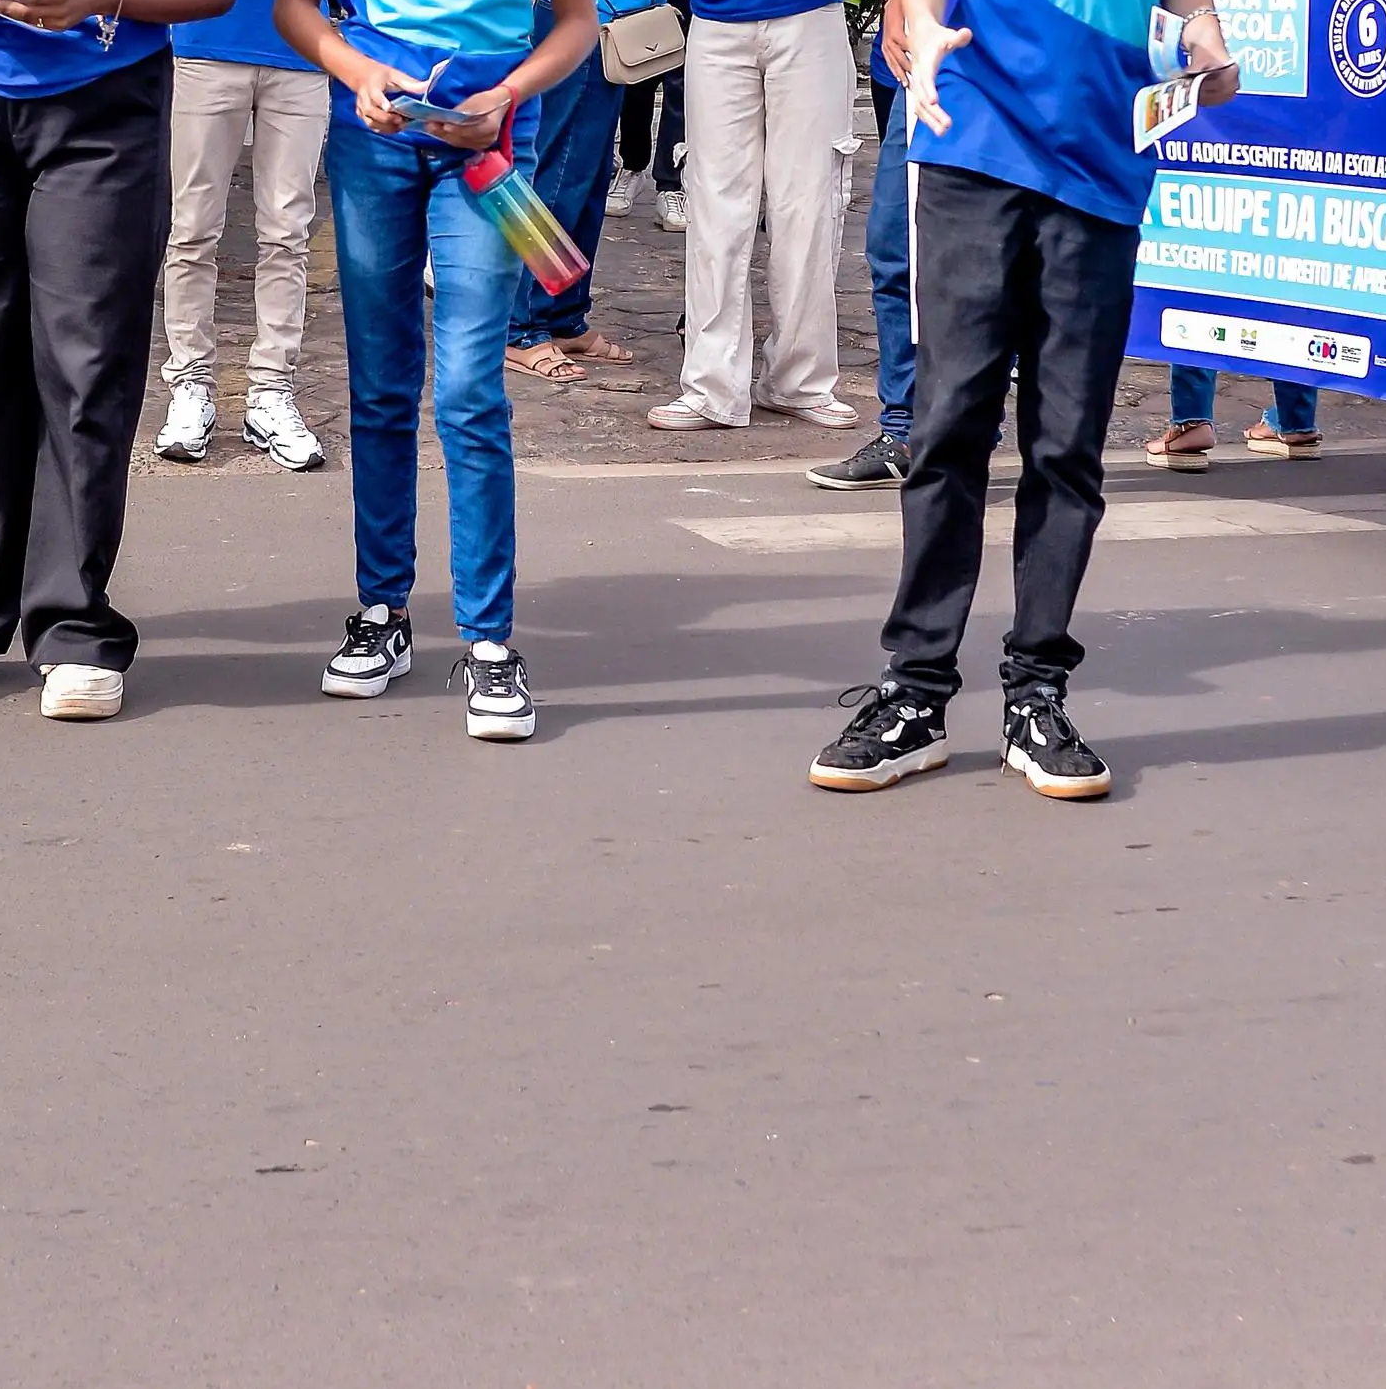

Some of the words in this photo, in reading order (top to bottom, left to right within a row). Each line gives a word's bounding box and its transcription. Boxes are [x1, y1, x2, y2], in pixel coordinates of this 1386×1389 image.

[1333, 13, 1346, 52] BUSCA
[1358, 2, 1377, 47] 6
[1357, 48, 1382, 68] ANOS
[1165, 141, 1188, 162] OU
[1191, 142, 1289, 170] ADOLESCENTE
[1289, 149, 1324, 173] FORA
[1324, 152, 1343, 175] DA
[1159, 182, 1273, 237] EQUIPE
[1276, 192, 1317, 242] DA
[1229, 249, 1262, 279] TEM
[1263, 254, 1275, 280] O
[1277, 255, 1332, 287] DIREITO
[1332, 263, 1353, 290] DE
